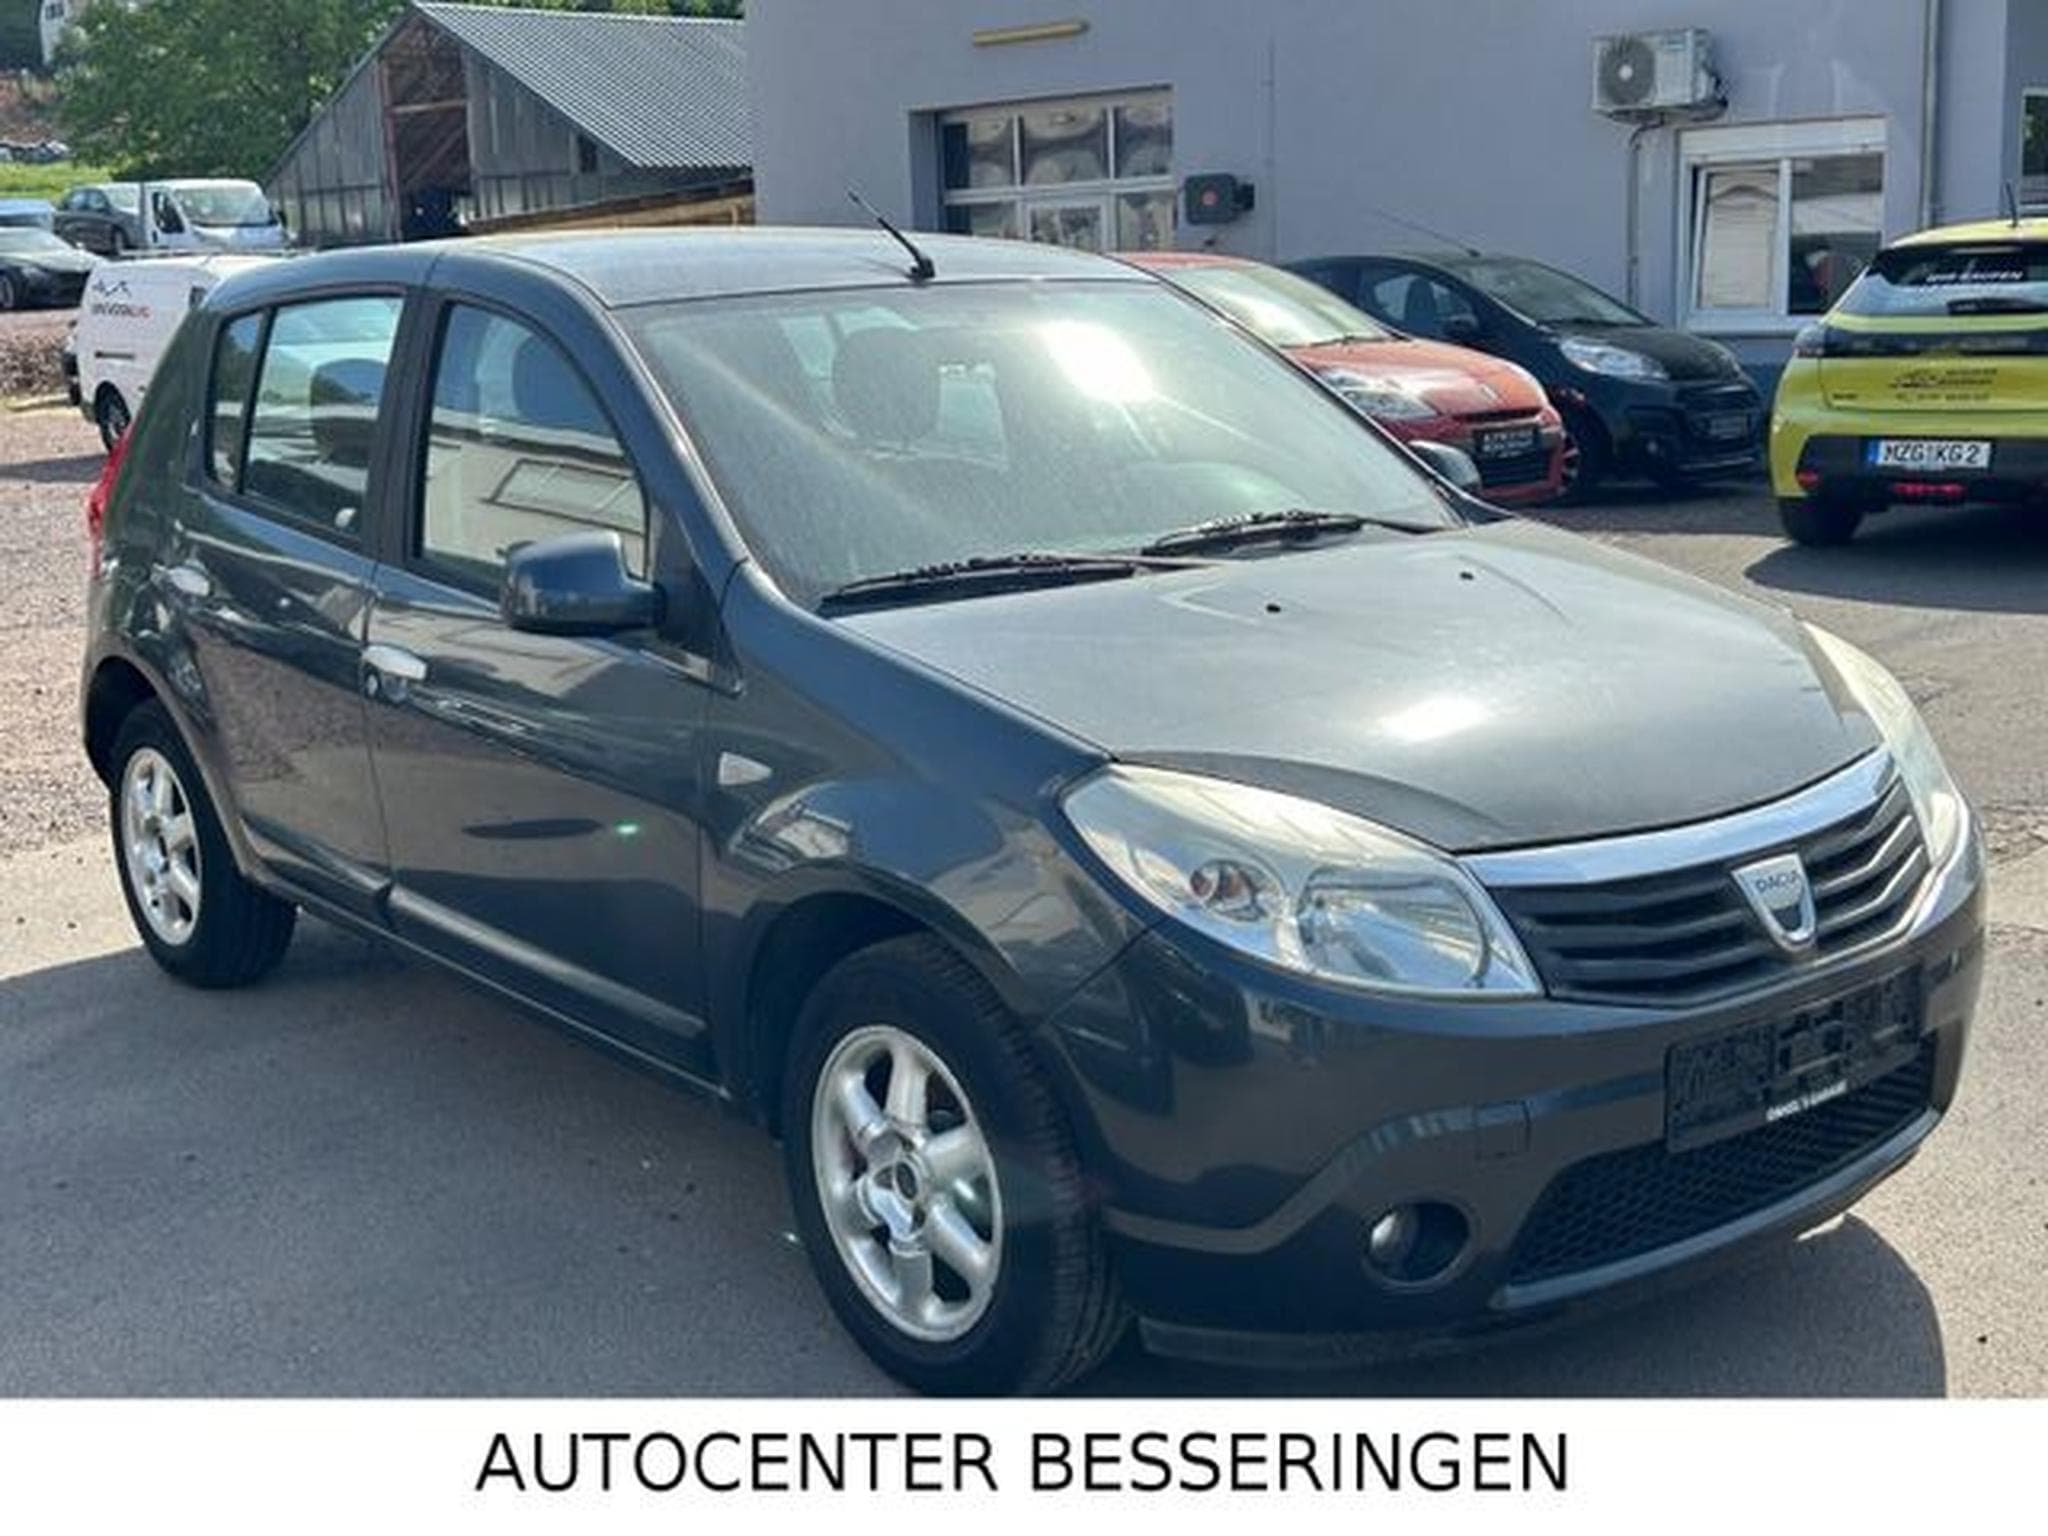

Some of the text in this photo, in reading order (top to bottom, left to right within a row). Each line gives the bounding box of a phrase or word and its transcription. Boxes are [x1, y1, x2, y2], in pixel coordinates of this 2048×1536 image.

[1884, 443, 1981, 464] MZG KG 2
